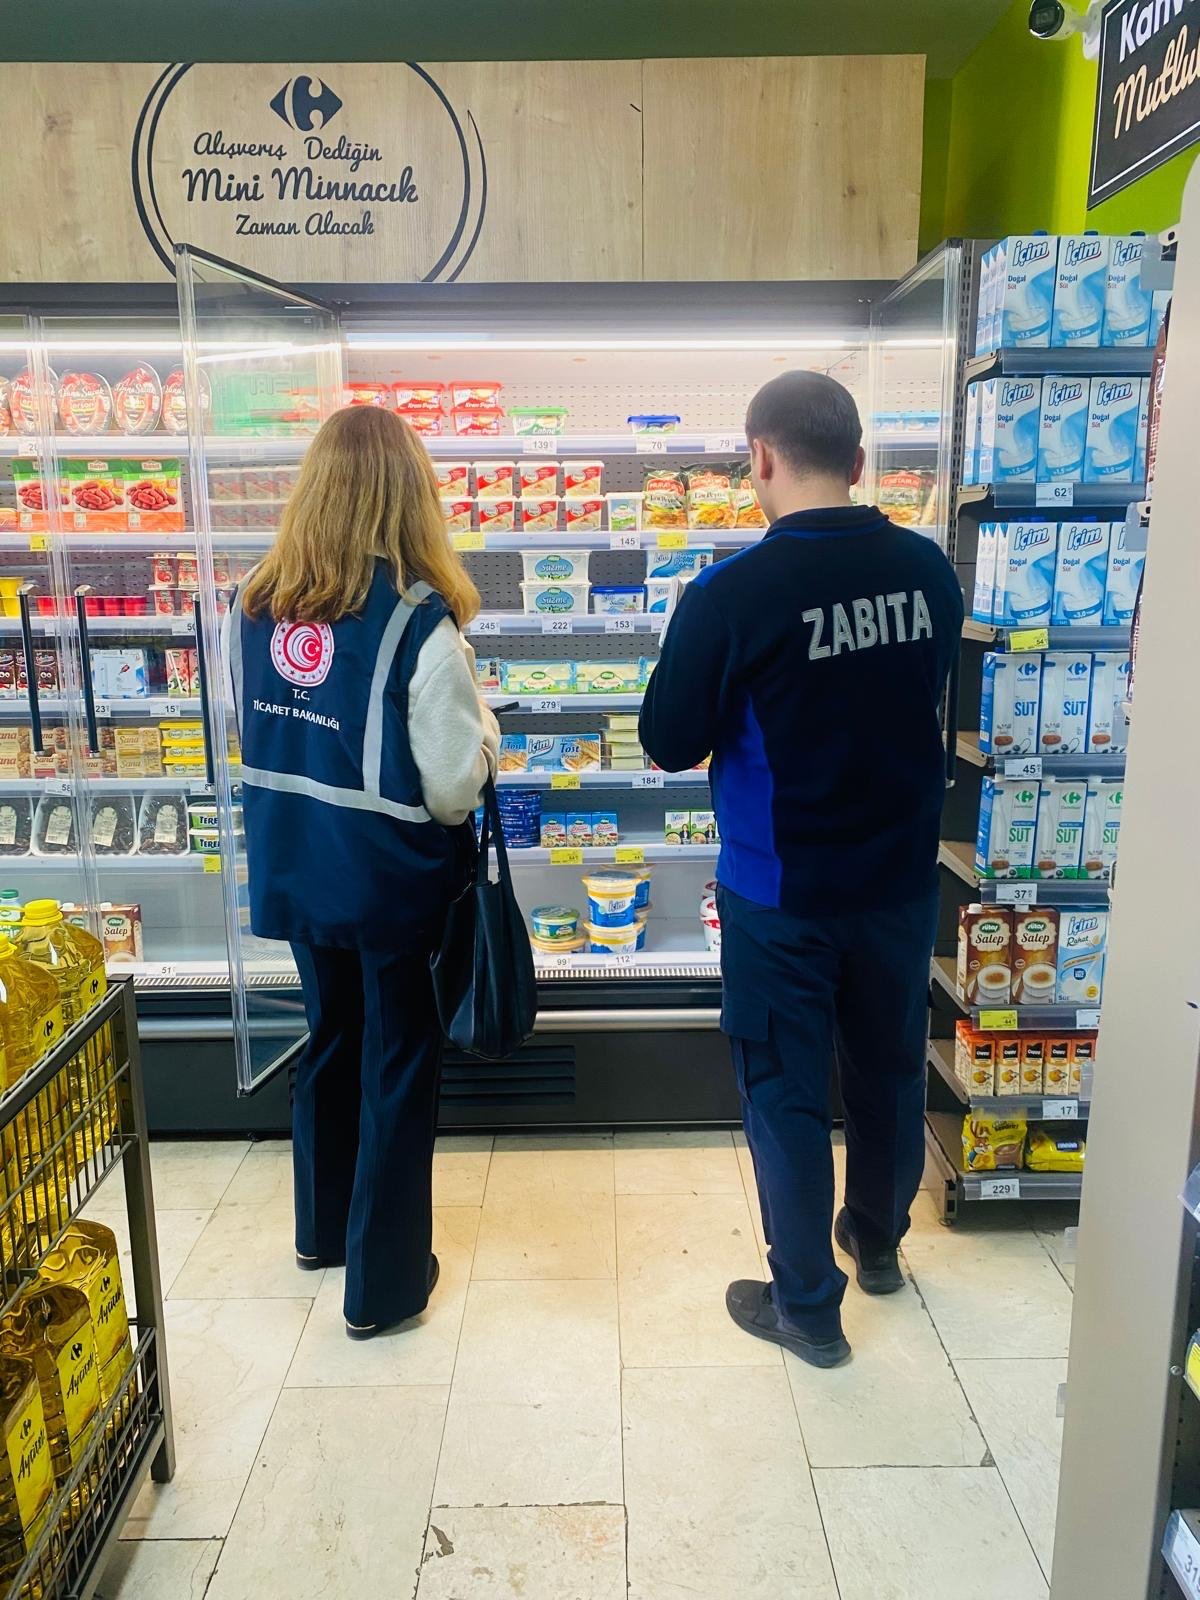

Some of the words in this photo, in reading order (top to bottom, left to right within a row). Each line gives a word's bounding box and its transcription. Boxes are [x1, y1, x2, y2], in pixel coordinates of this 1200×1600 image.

[304, 135, 382, 172] Dediğin
[182, 166, 264, 202] Mini
[271, 166, 418, 202] Minnacık
[236, 213, 300, 235] Zaman
[305, 211, 374, 235] Alacak
[1013, 240, 1049, 266] İçim
[1064, 240, 1101, 266] İçim
[1001, 381, 1035, 406] İçim
[1048, 381, 1082, 406] İçim
[1097, 381, 1132, 406] İçim
[533, 440, 549, 449] 139
[651, 441, 663, 449] 70
[719, 439, 730, 448] 79
[1054, 487, 1067, 497] 62
[619, 537, 635, 545] 145
[1014, 527, 1050, 551] İçim
[1067, 527, 1103, 550] İçim
[480, 621, 495, 630] 245
[552, 621, 568, 630] 222
[615, 620, 630, 629] 153
[801, 589, 933, 661] ZABITA
[292, 688, 310, 701] T.C.
[95, 705, 106, 713] 23
[165, 705, 176, 713] 15
[541, 701, 556, 709] 279
[1014, 700, 1037, 716] SÜT
[1063, 700, 1087, 716] SÜT
[253, 699, 291, 717] TİCARET
[292, 707, 340, 731] BAKANLIĞI
[118, 735, 139, 744] Sana
[560, 742, 580, 754] Tost
[1022, 764, 1036, 774] 45
[641, 776, 656, 785] 184
[1009, 828, 1031, 843] SÜT
[1056, 828, 1079, 843] SÜT
[1014, 889, 1027, 899] 37
[104, 927, 128, 936] Salep
[1067, 916, 1099, 936] İçim
[975, 933, 1004, 945] Salep
[1021, 932, 1050, 945] Salep
[615, 956, 630, 964] 112
[162, 966, 172, 974] 51
[1060, 1106, 1072, 1115] 17
[992, 1184, 1011, 1194] 229
